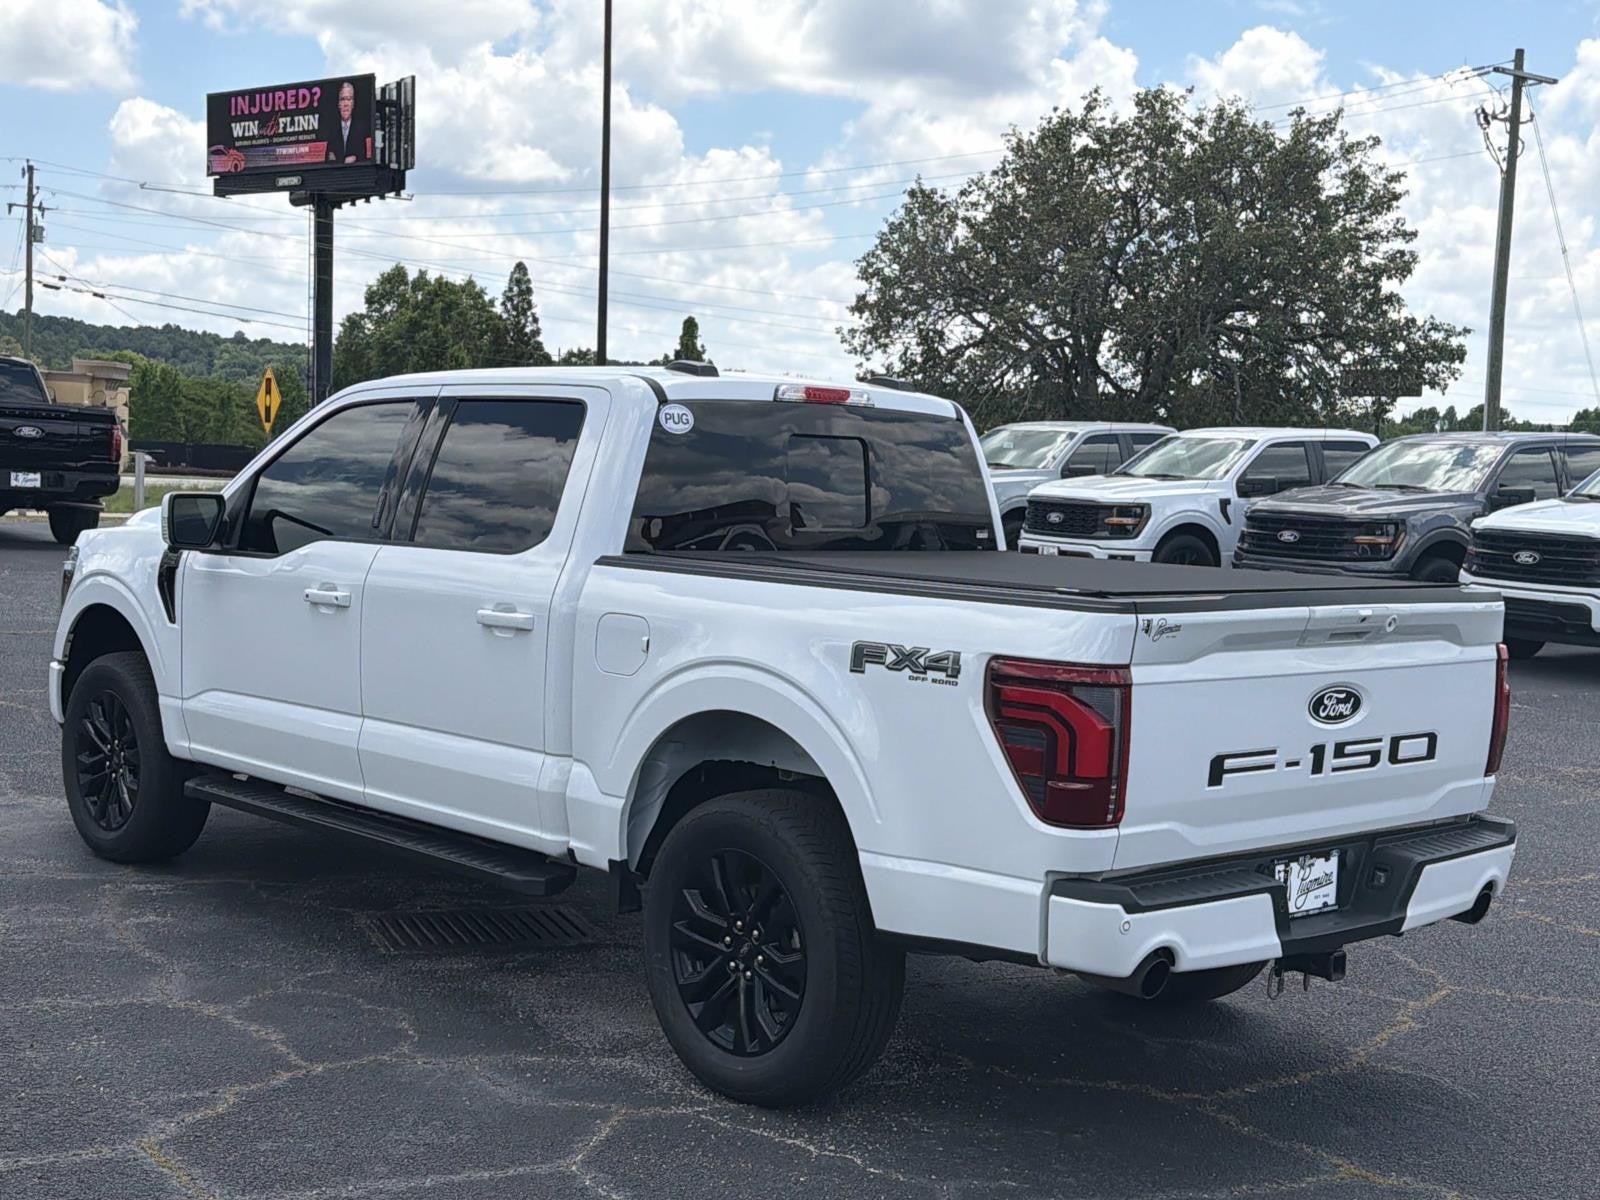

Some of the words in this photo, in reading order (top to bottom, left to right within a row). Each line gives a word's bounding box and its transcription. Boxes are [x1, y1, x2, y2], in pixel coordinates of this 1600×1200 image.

[231, 87, 321, 116] INJURED?
[231, 120, 259, 138] WIN
[278, 114, 319, 133] FLINN
[664, 412, 690, 425] PUG
[849, 640, 961, 679] FX4
[908, 674, 928, 682] OFF
[931, 678, 959, 687] ROAD
[1319, 691, 1354, 718] Ford
[1207, 731, 1438, 788] F-150
